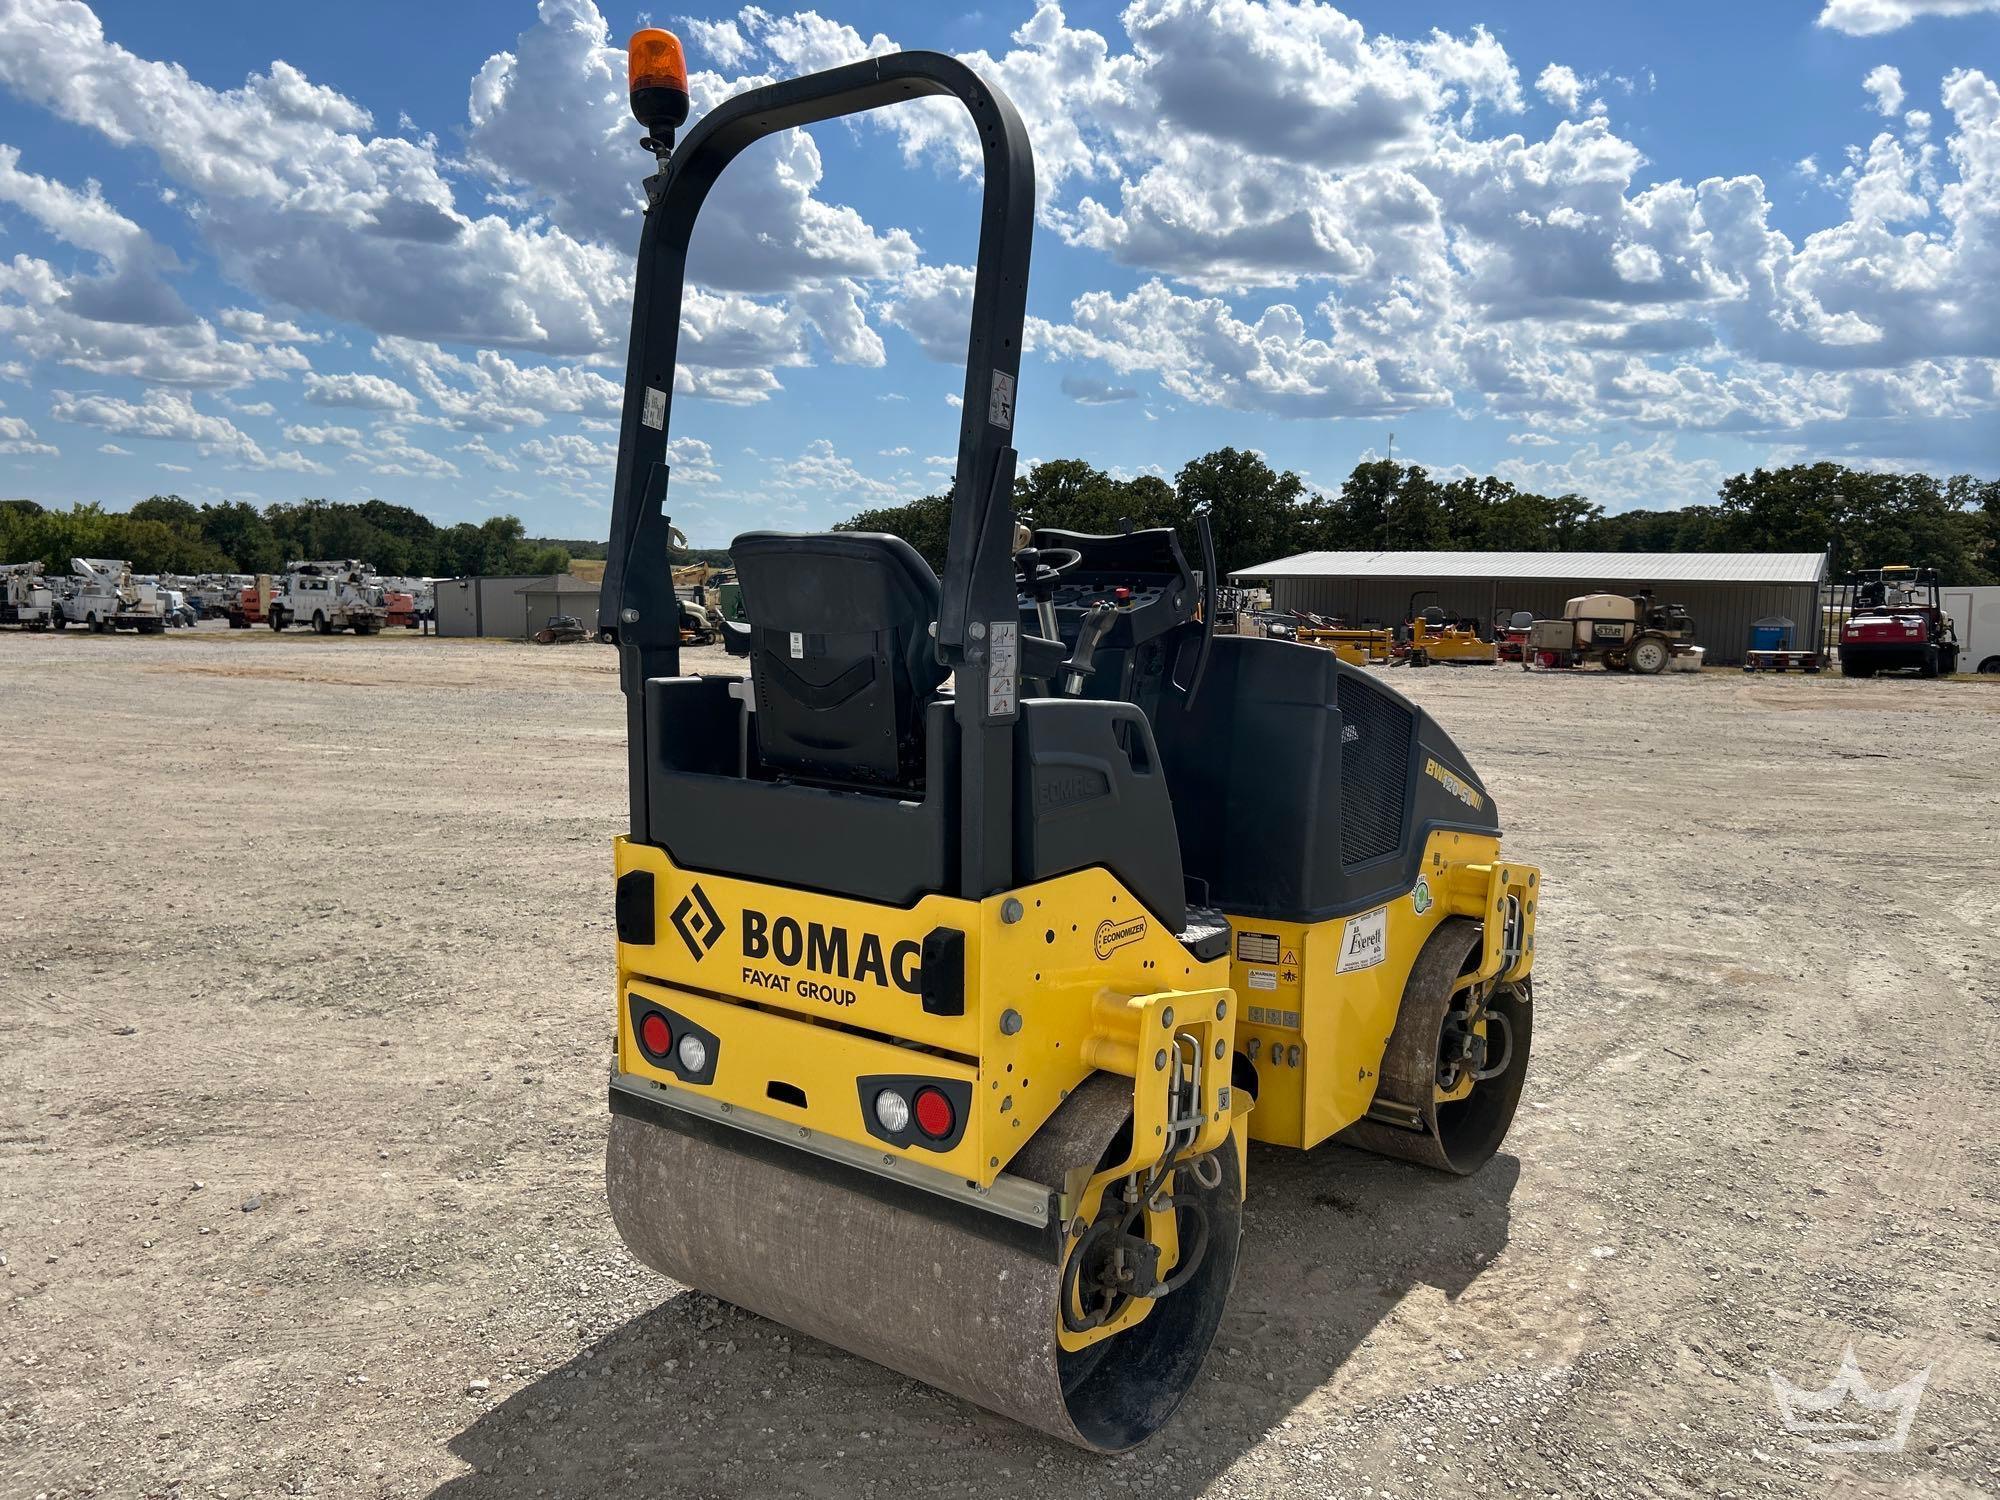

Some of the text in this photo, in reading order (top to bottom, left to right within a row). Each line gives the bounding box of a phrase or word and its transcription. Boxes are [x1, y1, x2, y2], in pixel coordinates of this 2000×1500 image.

[1039, 774, 1097, 805] BOMAG
[743, 909, 922, 994] BOMAG
[1102, 923, 1145, 945] ECONOMIZER
[742, 967, 857, 1007] FAYAT GROUP
